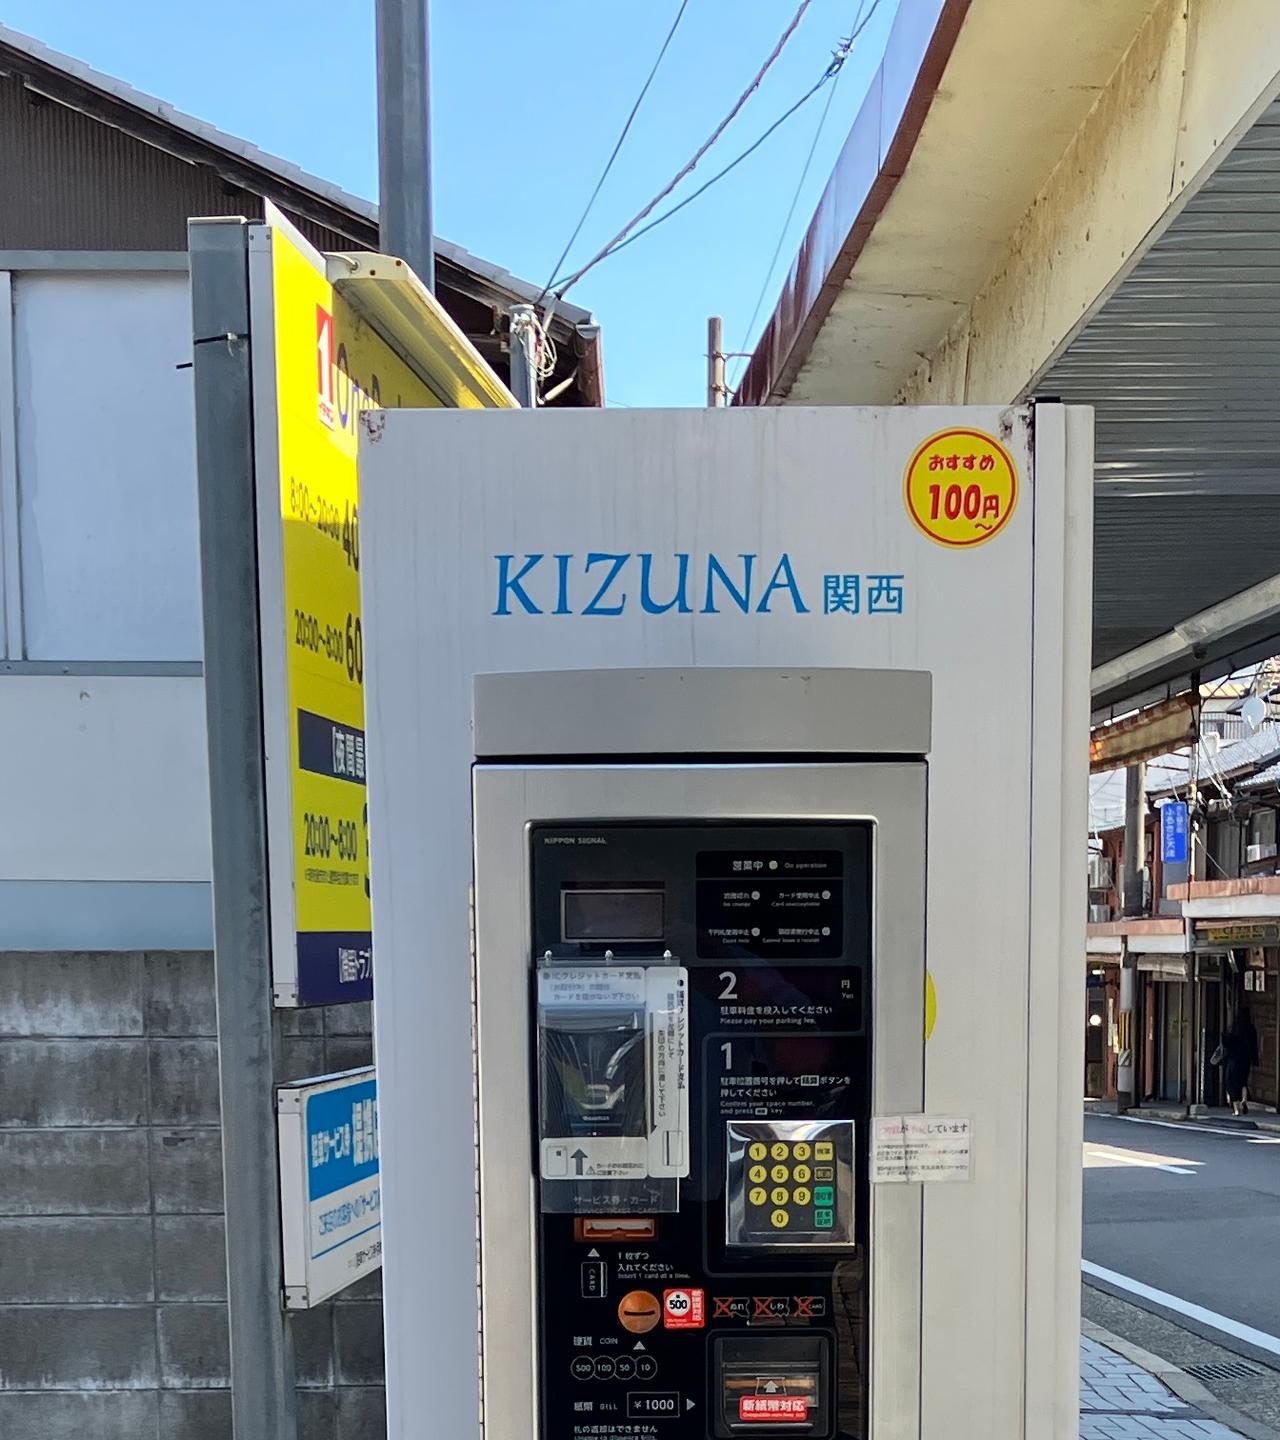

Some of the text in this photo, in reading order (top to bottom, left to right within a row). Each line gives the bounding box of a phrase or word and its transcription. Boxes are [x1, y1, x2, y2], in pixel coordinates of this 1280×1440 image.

[929, 454, 995, 472] おすすめ
[491, 552, 904, 616] KIZUNA 関西
[544, 837, 607, 845] NIPPON SIGNAL
[718, 971, 738, 999] 2
[841, 980, 850, 989] 円
[720, 1006, 832, 1015] 駐車料金を投入してください
[721, 1042, 732, 1070] 1
[720, 1089, 777, 1097] 押してください
[755, 1147, 761, 1157] 1
[777, 1147, 784, 1157] 2
[799, 1147, 806, 1157] 3
[754, 1169, 761, 1178] 4
[777, 1169, 784, 1179] 5
[799, 1169, 806, 1179] 6
[754, 1191, 762, 1201] 7
[777, 1191, 784, 1201] 8
[799, 1191, 806, 1201] 9
[777, 1213, 784, 1223] 0
[617, 1263, 674, 1271] 入れてください
[588, 1268, 596, 1291] CARD
[669, 1299, 688, 1309] 500
[600, 1337, 618, 1345] COIN
[576, 1364, 592, 1372] 500
[597, 1364, 612, 1372] 100
[620, 1364, 630, 1372] 50
